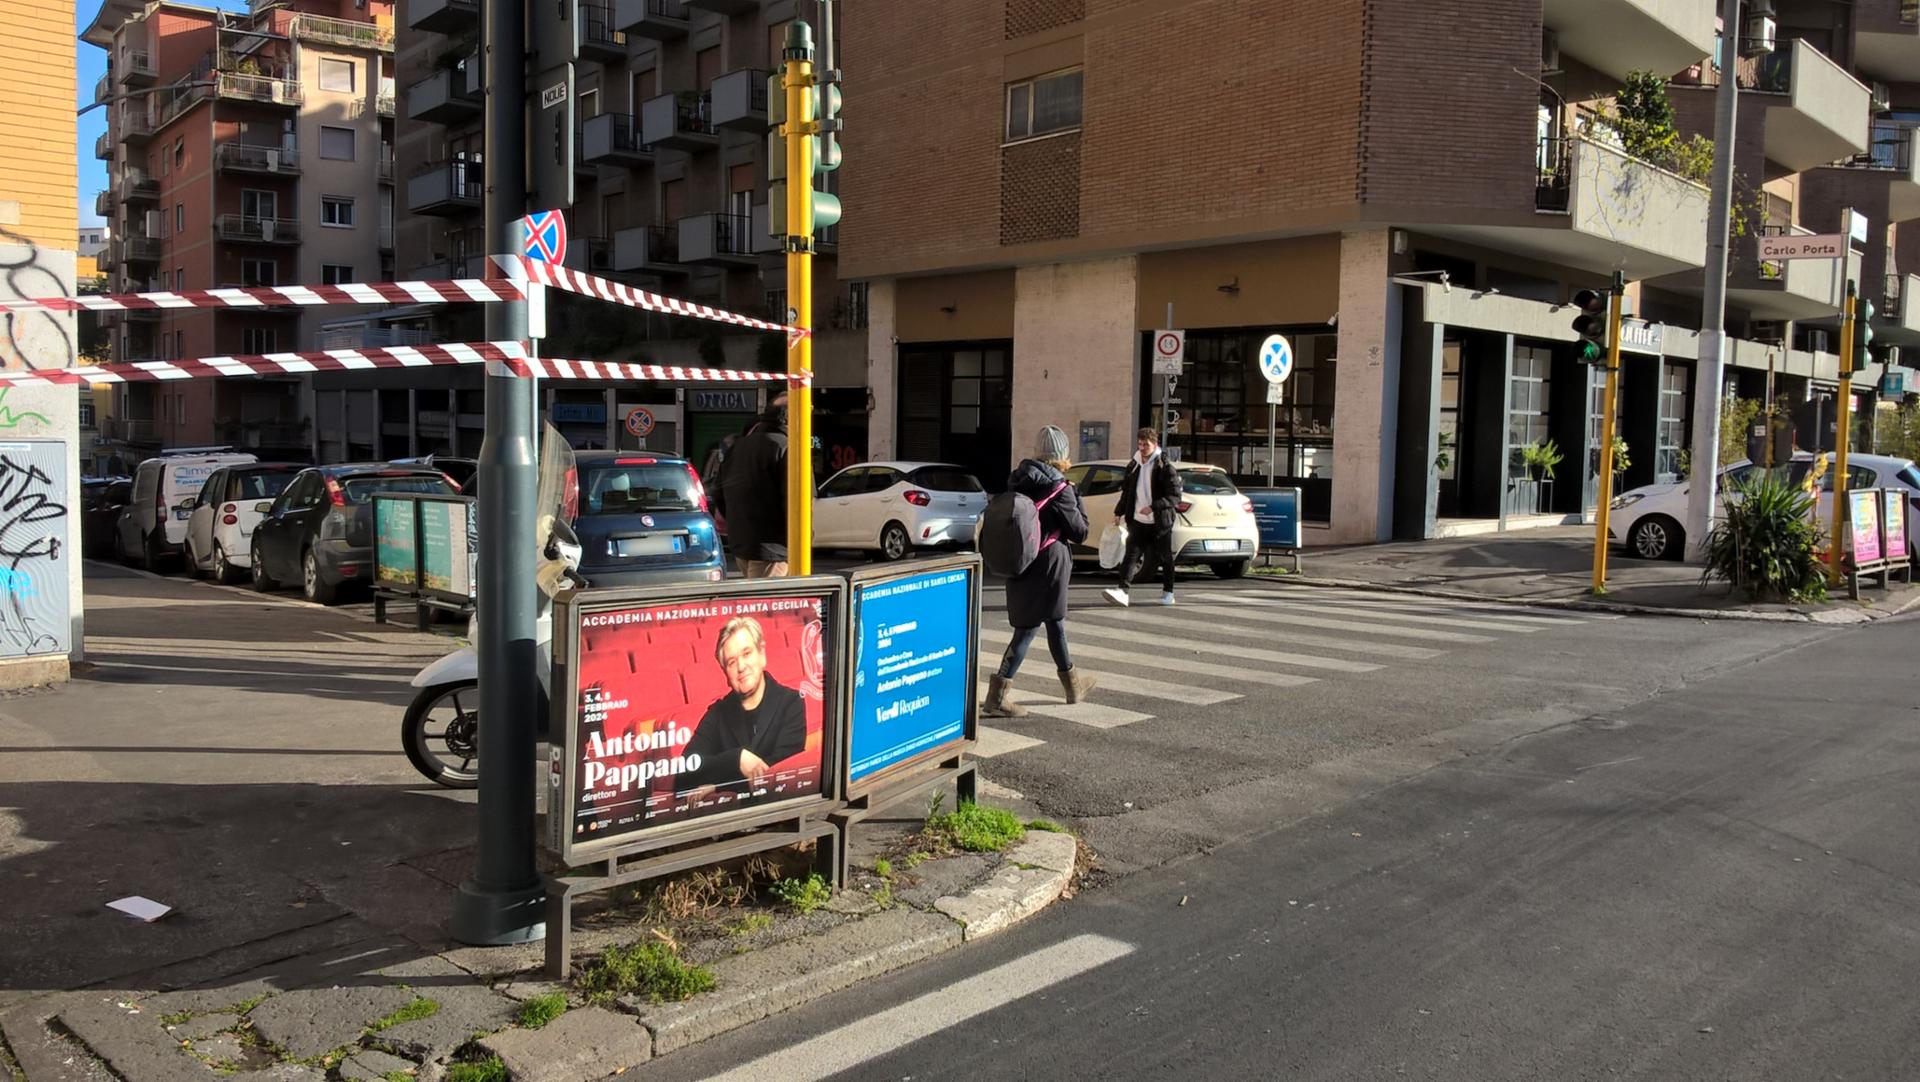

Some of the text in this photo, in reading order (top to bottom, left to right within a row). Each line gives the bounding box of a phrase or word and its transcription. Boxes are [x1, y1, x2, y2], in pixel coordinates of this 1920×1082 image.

[1763, 244, 1836, 256] Carlo Porta
[696, 391, 747, 409] OTTICA
[861, 588, 892, 601] CCADEMIA
[582, 599, 809, 628] ACCADEMIA NAZIONALE DI SANTA CECILIA
[584, 699, 629, 713] FEBBRAIO
[876, 696, 930, 723] Verdi Requiem
[583, 711, 608, 723] 2024
[583, 720, 692, 760] Antonio
[583, 753, 702, 792] Pappano
[582, 789, 617, 802] direttore
